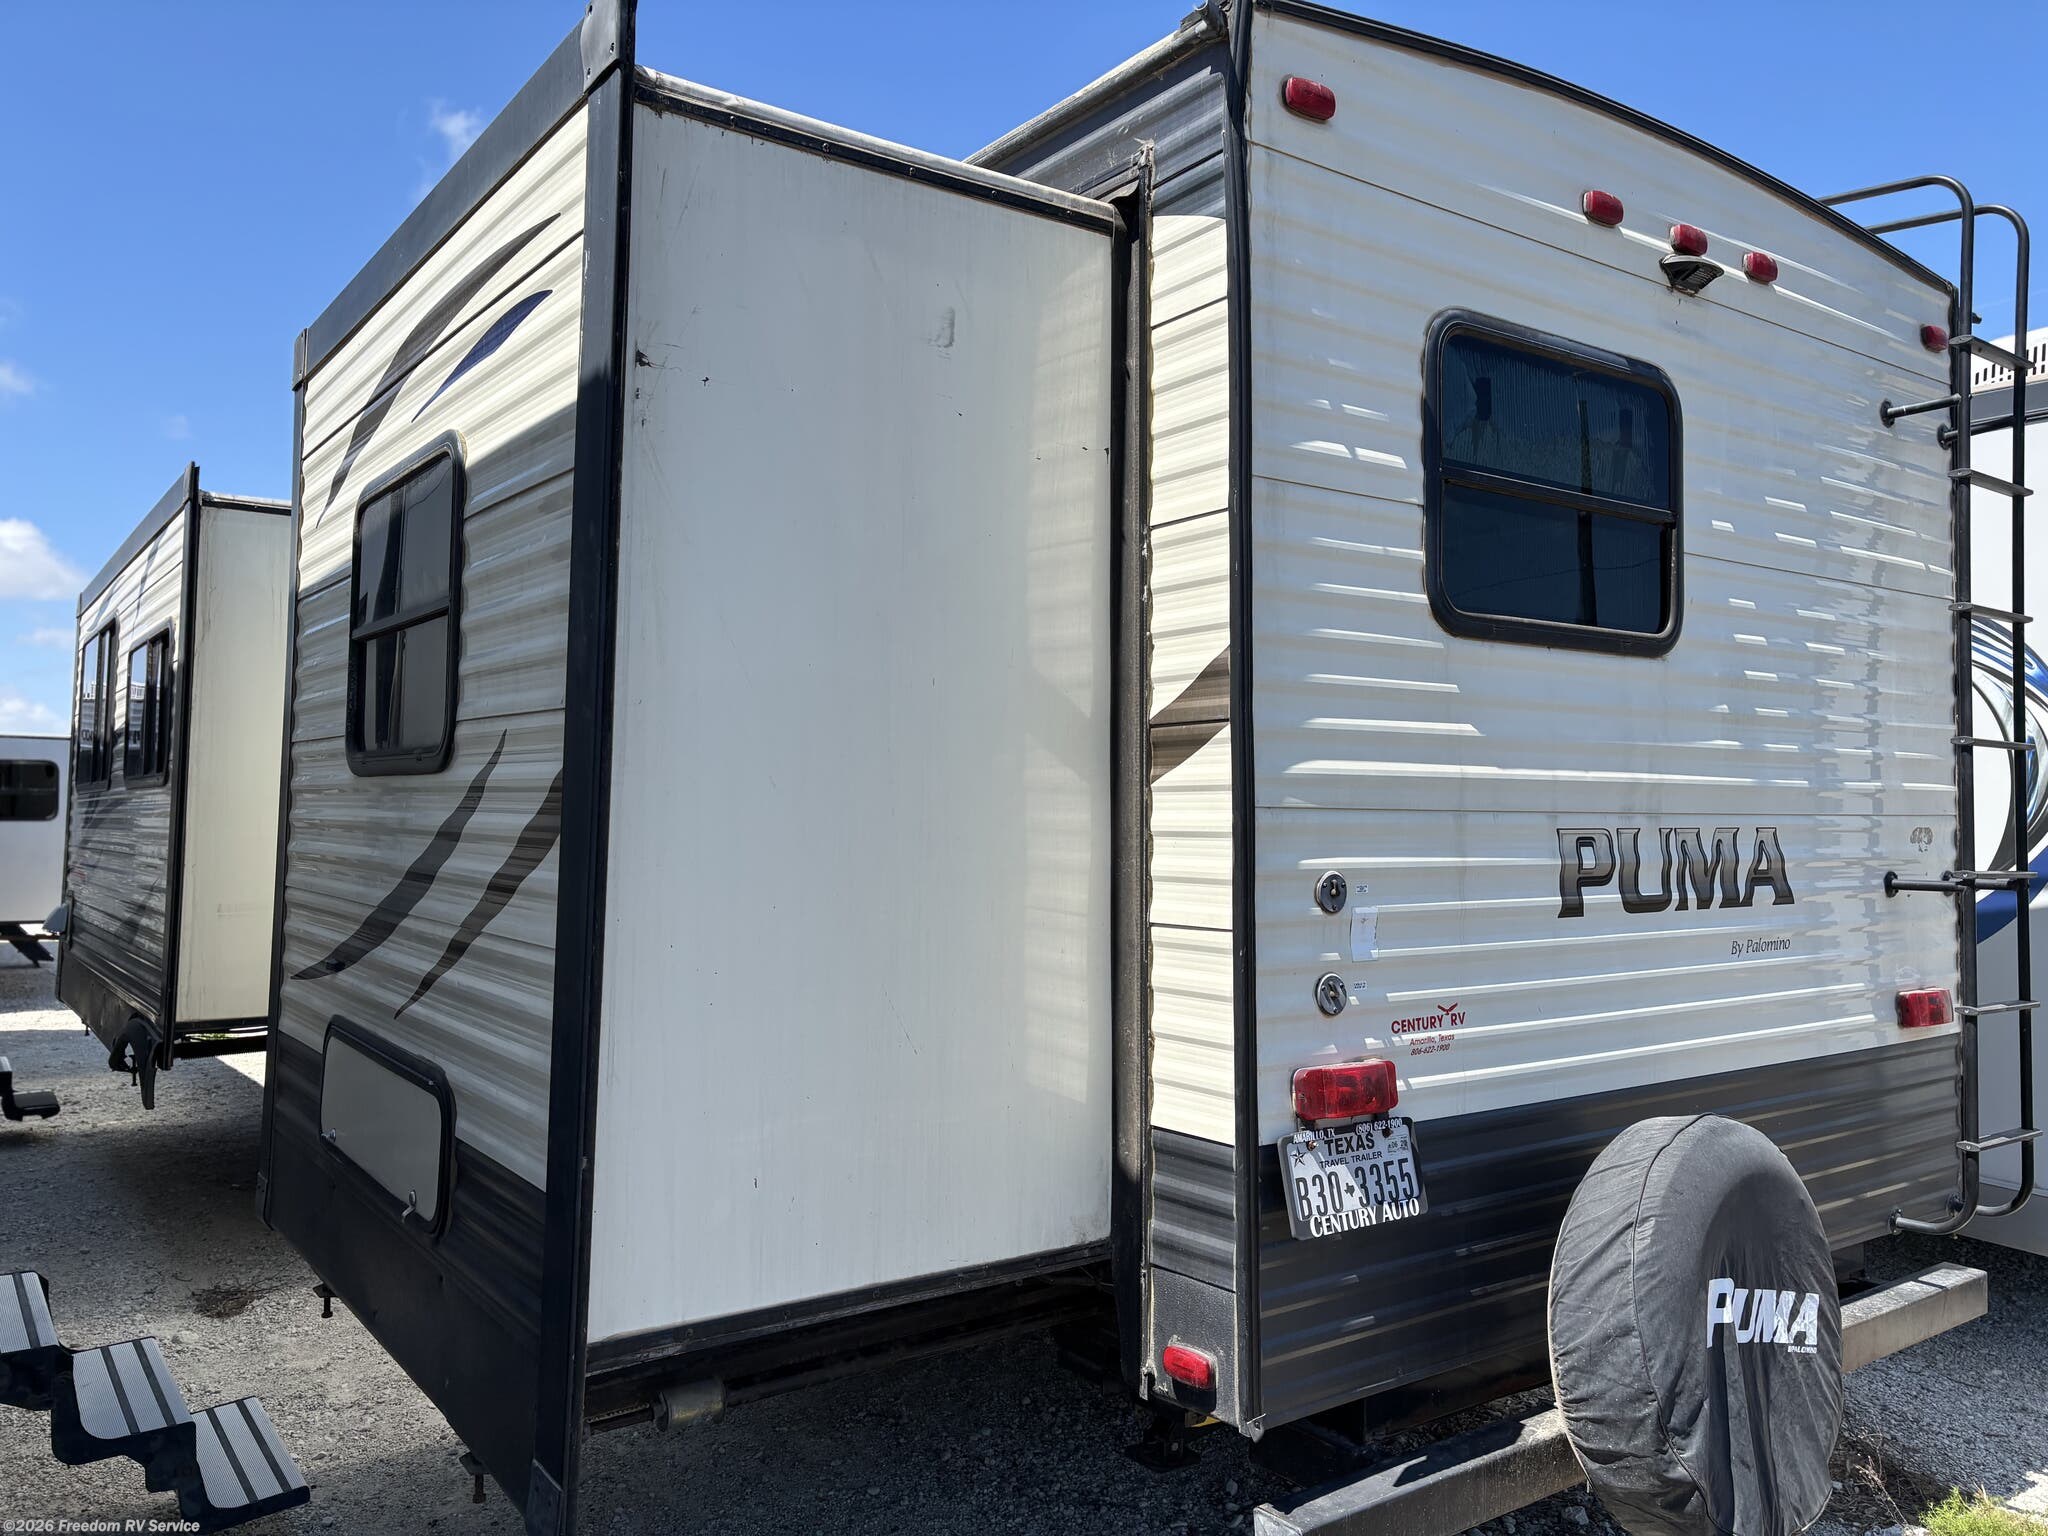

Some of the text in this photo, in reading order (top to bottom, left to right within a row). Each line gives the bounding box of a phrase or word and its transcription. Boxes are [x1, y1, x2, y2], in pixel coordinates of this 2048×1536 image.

[1557, 827, 1795, 918] PUMA
[1731, 937, 1791, 958] By Palomino
[1391, 1012, 1466, 1034] CENTURY RV
[1409, 1034, 1455, 1046] Amarillo, Texas
[1324, 1132, 1375, 1156] TEXAS
[1327, 1128, 1336, 1138] TX
[1320, 1158, 1350, 1169] TRAVEL
[1351, 1151, 1383, 1164] TRAILER
[1310, 1198, 1420, 1238] CENTURY AUTO
[1707, 1278, 1820, 1349] PUMA
